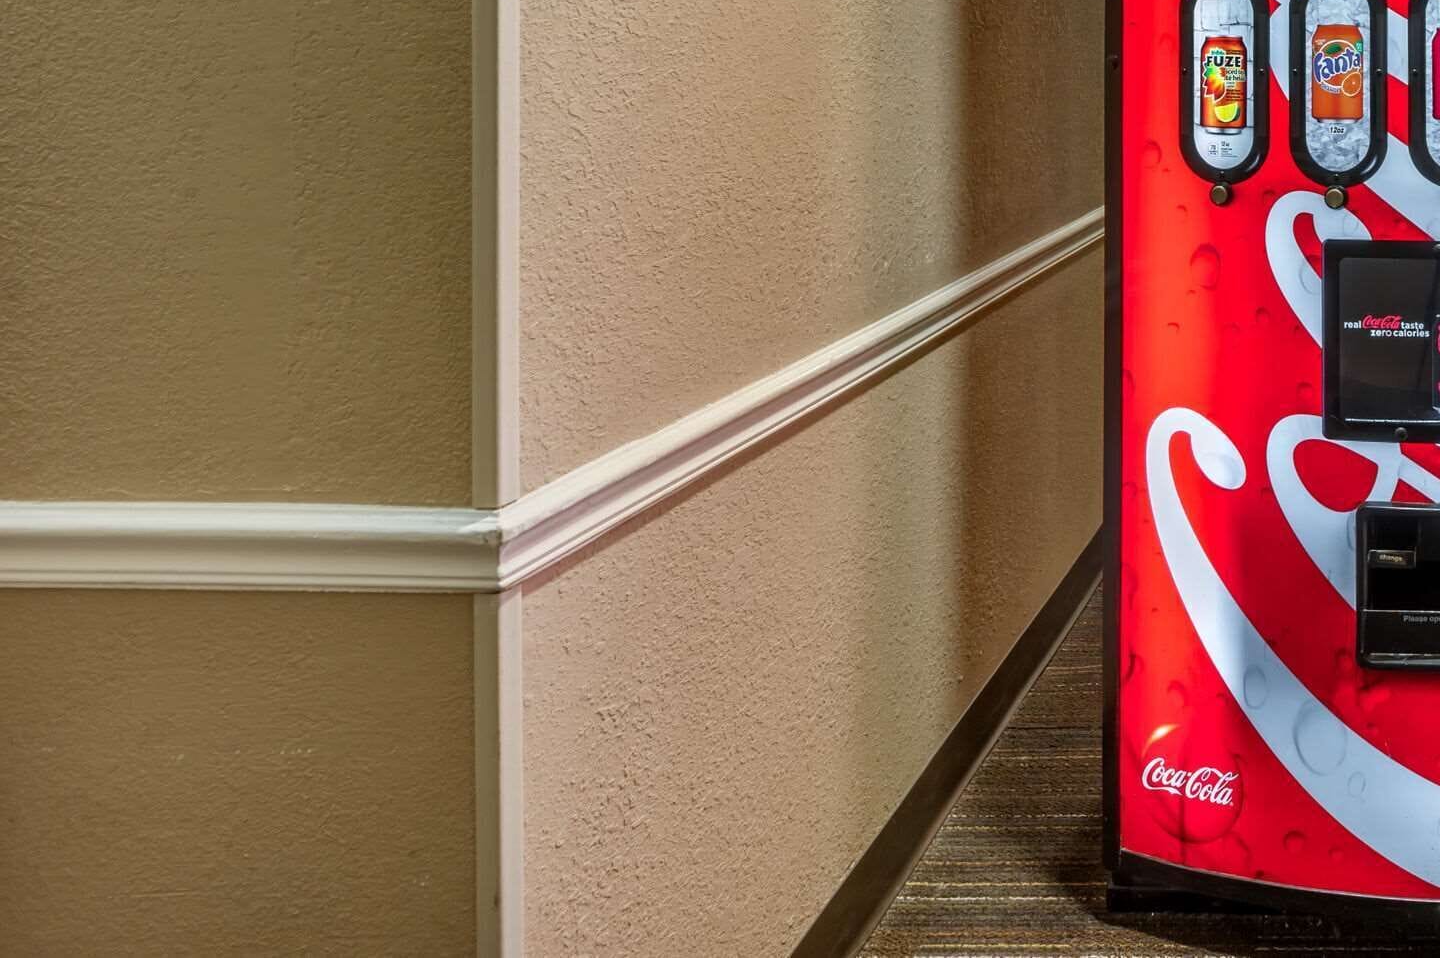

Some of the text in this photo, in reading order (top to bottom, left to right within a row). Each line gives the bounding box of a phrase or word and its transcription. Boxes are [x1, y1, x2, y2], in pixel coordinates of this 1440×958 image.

[1206, 55, 1242, 68] FUZE
[1343, 320, 1362, 329] real
[1401, 321, 1425, 330] taste
[1370, 329, 1430, 338] zero calories
[1402, 614, 1428, 623] Please
[1141, 756, 1240, 807] Coca-Cola
